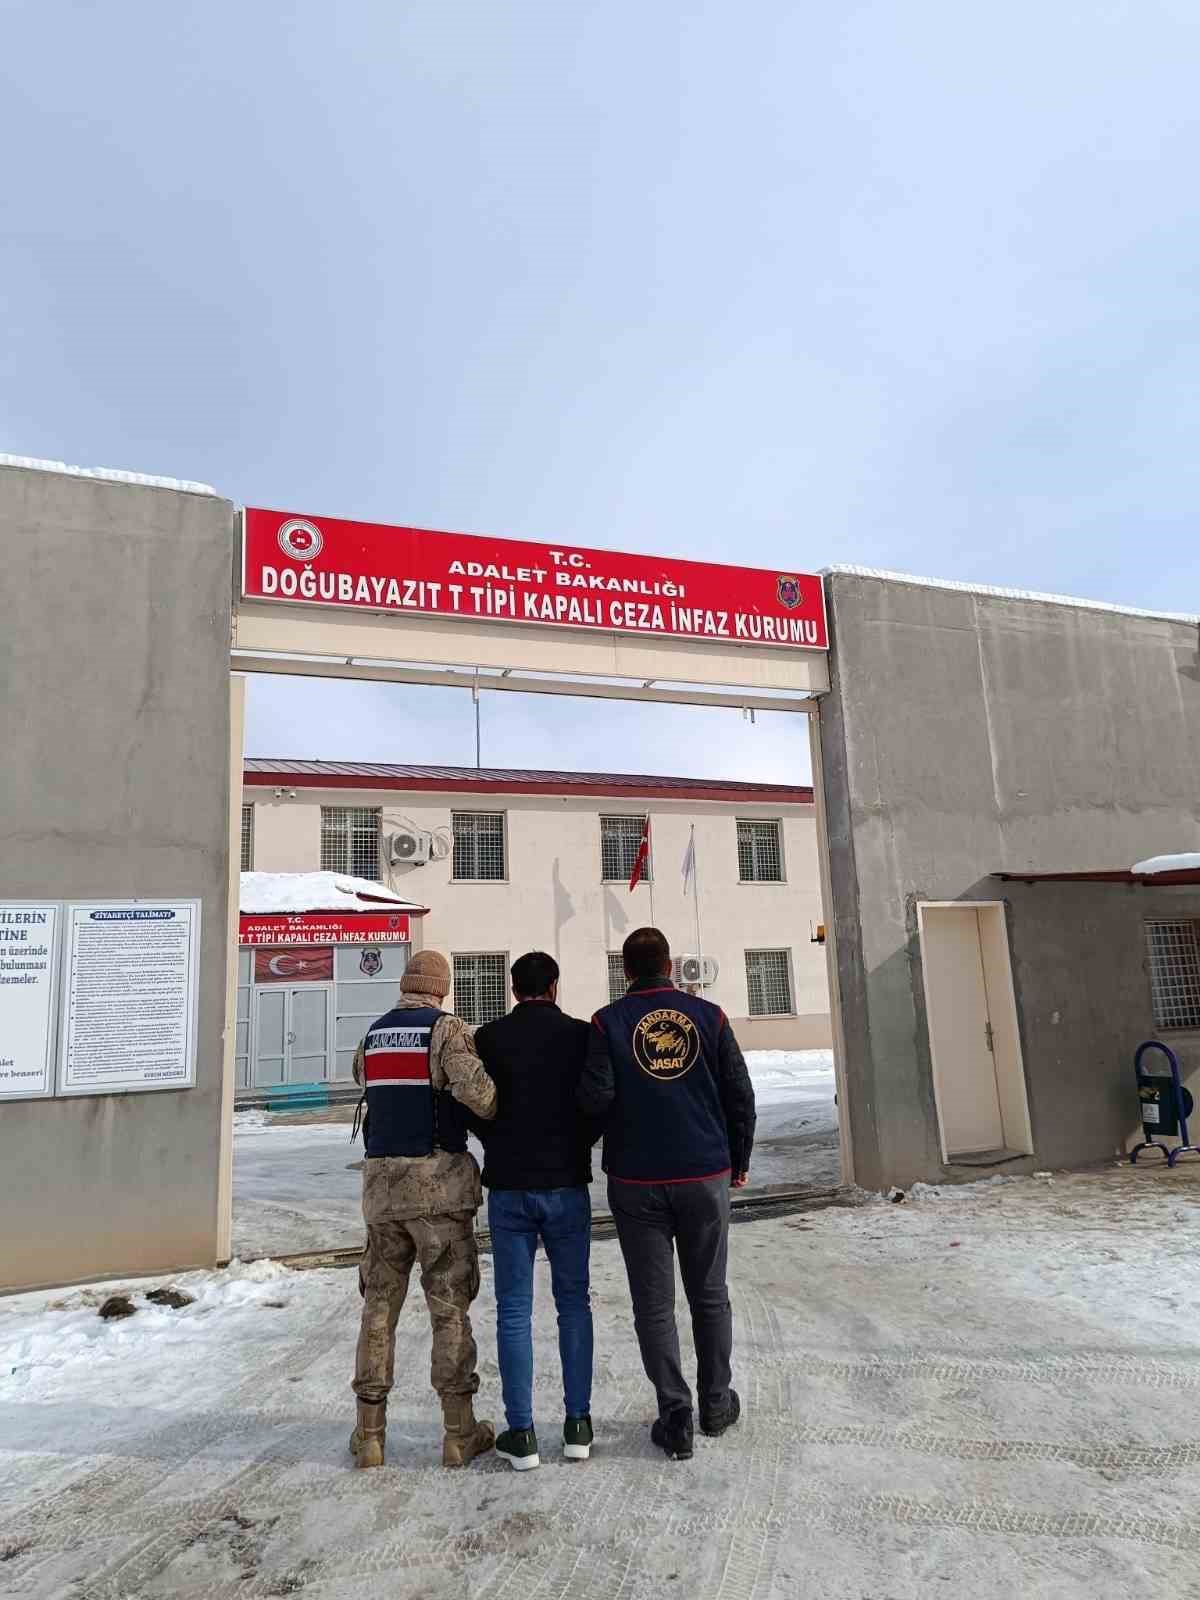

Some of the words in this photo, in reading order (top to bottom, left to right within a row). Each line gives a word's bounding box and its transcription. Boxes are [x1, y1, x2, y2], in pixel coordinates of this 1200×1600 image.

[549, 551, 591, 568] T.C.
[448, 560, 547, 583] ADALET
[555, 572, 685, 598] BAKANLIĞI
[262, 563, 442, 609] DOĞUBAYAZIT
[448, 584, 463, 611] T
[470, 582, 516, 617] TİPİ
[523, 592, 602, 624] KAPALI
[609, 600, 665, 630] CEZA
[671, 603, 730, 636] İNFAZ
[735, 613, 818, 643] KURUMU
[0, 910, 47, 924] İLERİN
[287, 916, 305, 924] T.C.
[247, 933, 254, 943] T
[255, 931, 275, 943] TİPİ
[277, 931, 311, 943] KAPALI
[313, 931, 337, 941] CEZA
[339, 930, 366, 941] İNFAZ
[367, 931, 406, 941] KURUMU
[8, 945, 48, 956] üzerinde
[638, 1011, 692, 1034] JANDARMA
[369, 1032, 422, 1049] JANDARMA
[649, 1057, 684, 1071] JASAT
